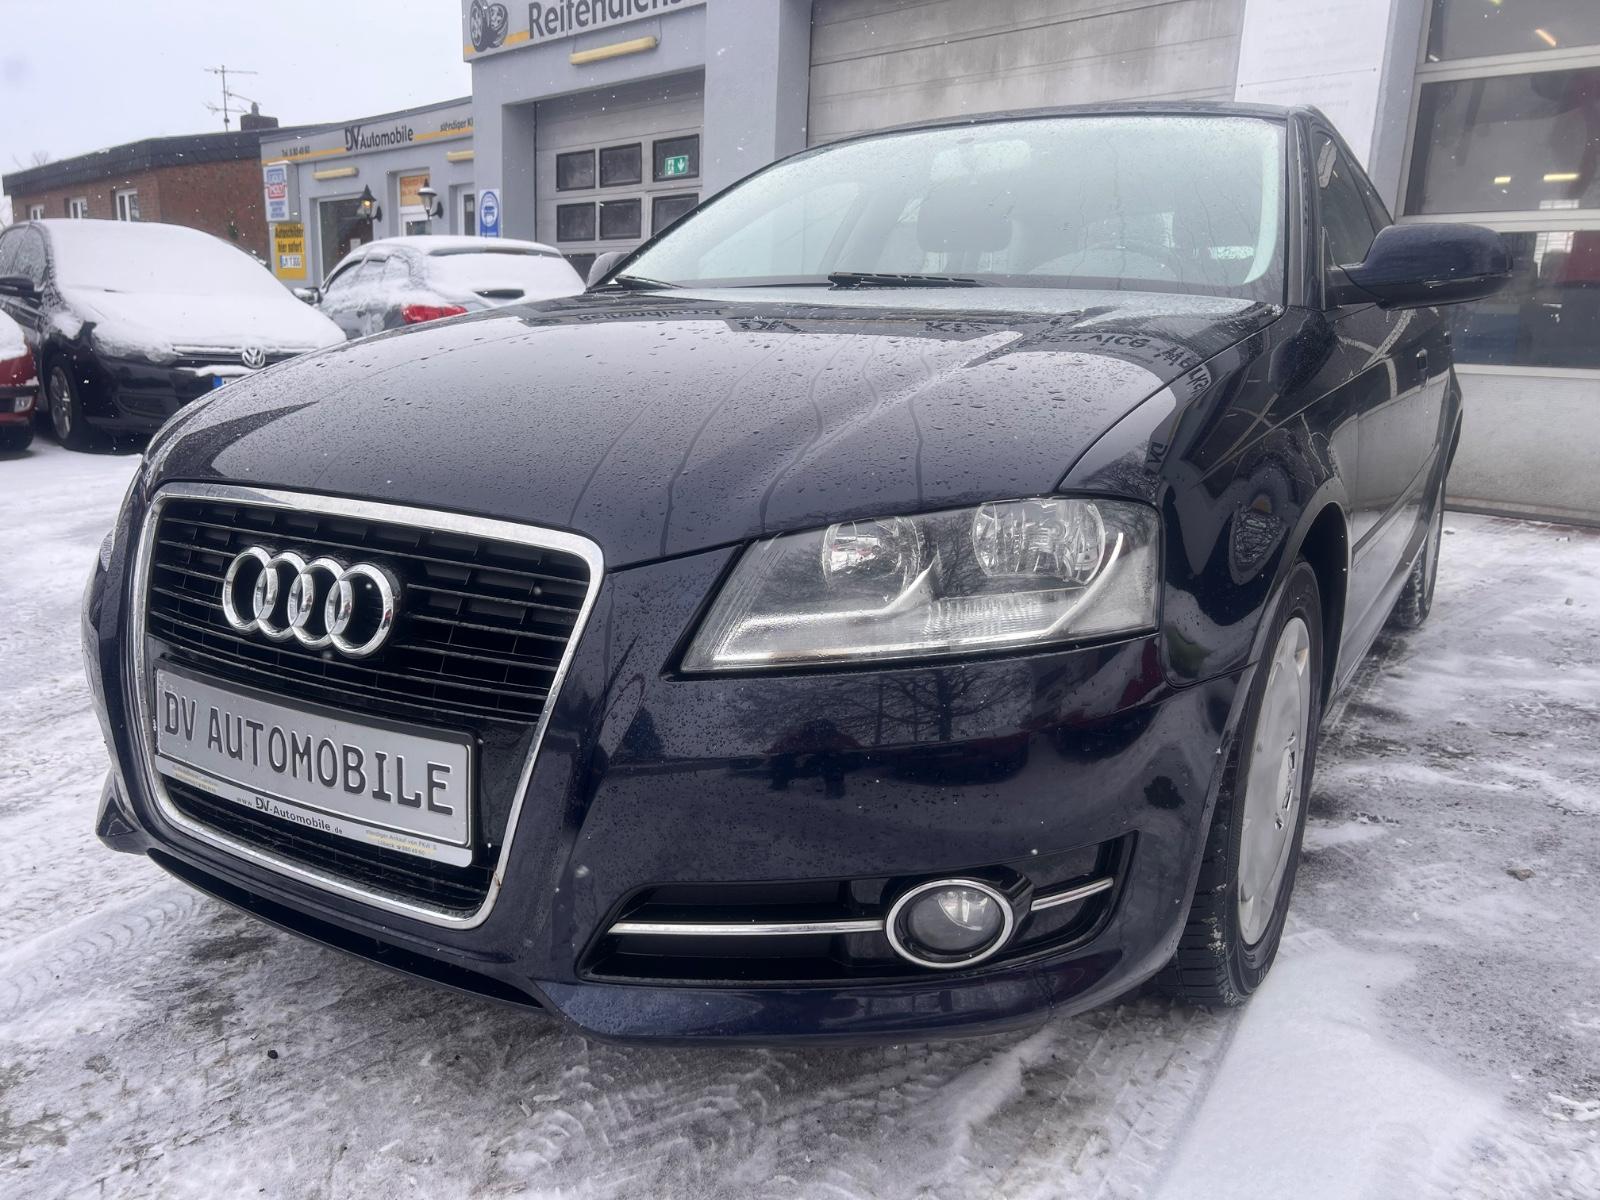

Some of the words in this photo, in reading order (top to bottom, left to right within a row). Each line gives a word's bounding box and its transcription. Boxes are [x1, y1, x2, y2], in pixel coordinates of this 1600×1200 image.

[529, 0, 681, 39] Reifendie
[360, 125, 414, 149] Automobile
[164, 690, 196, 741] DV
[207, 707, 453, 816] AUTOMOBILE
